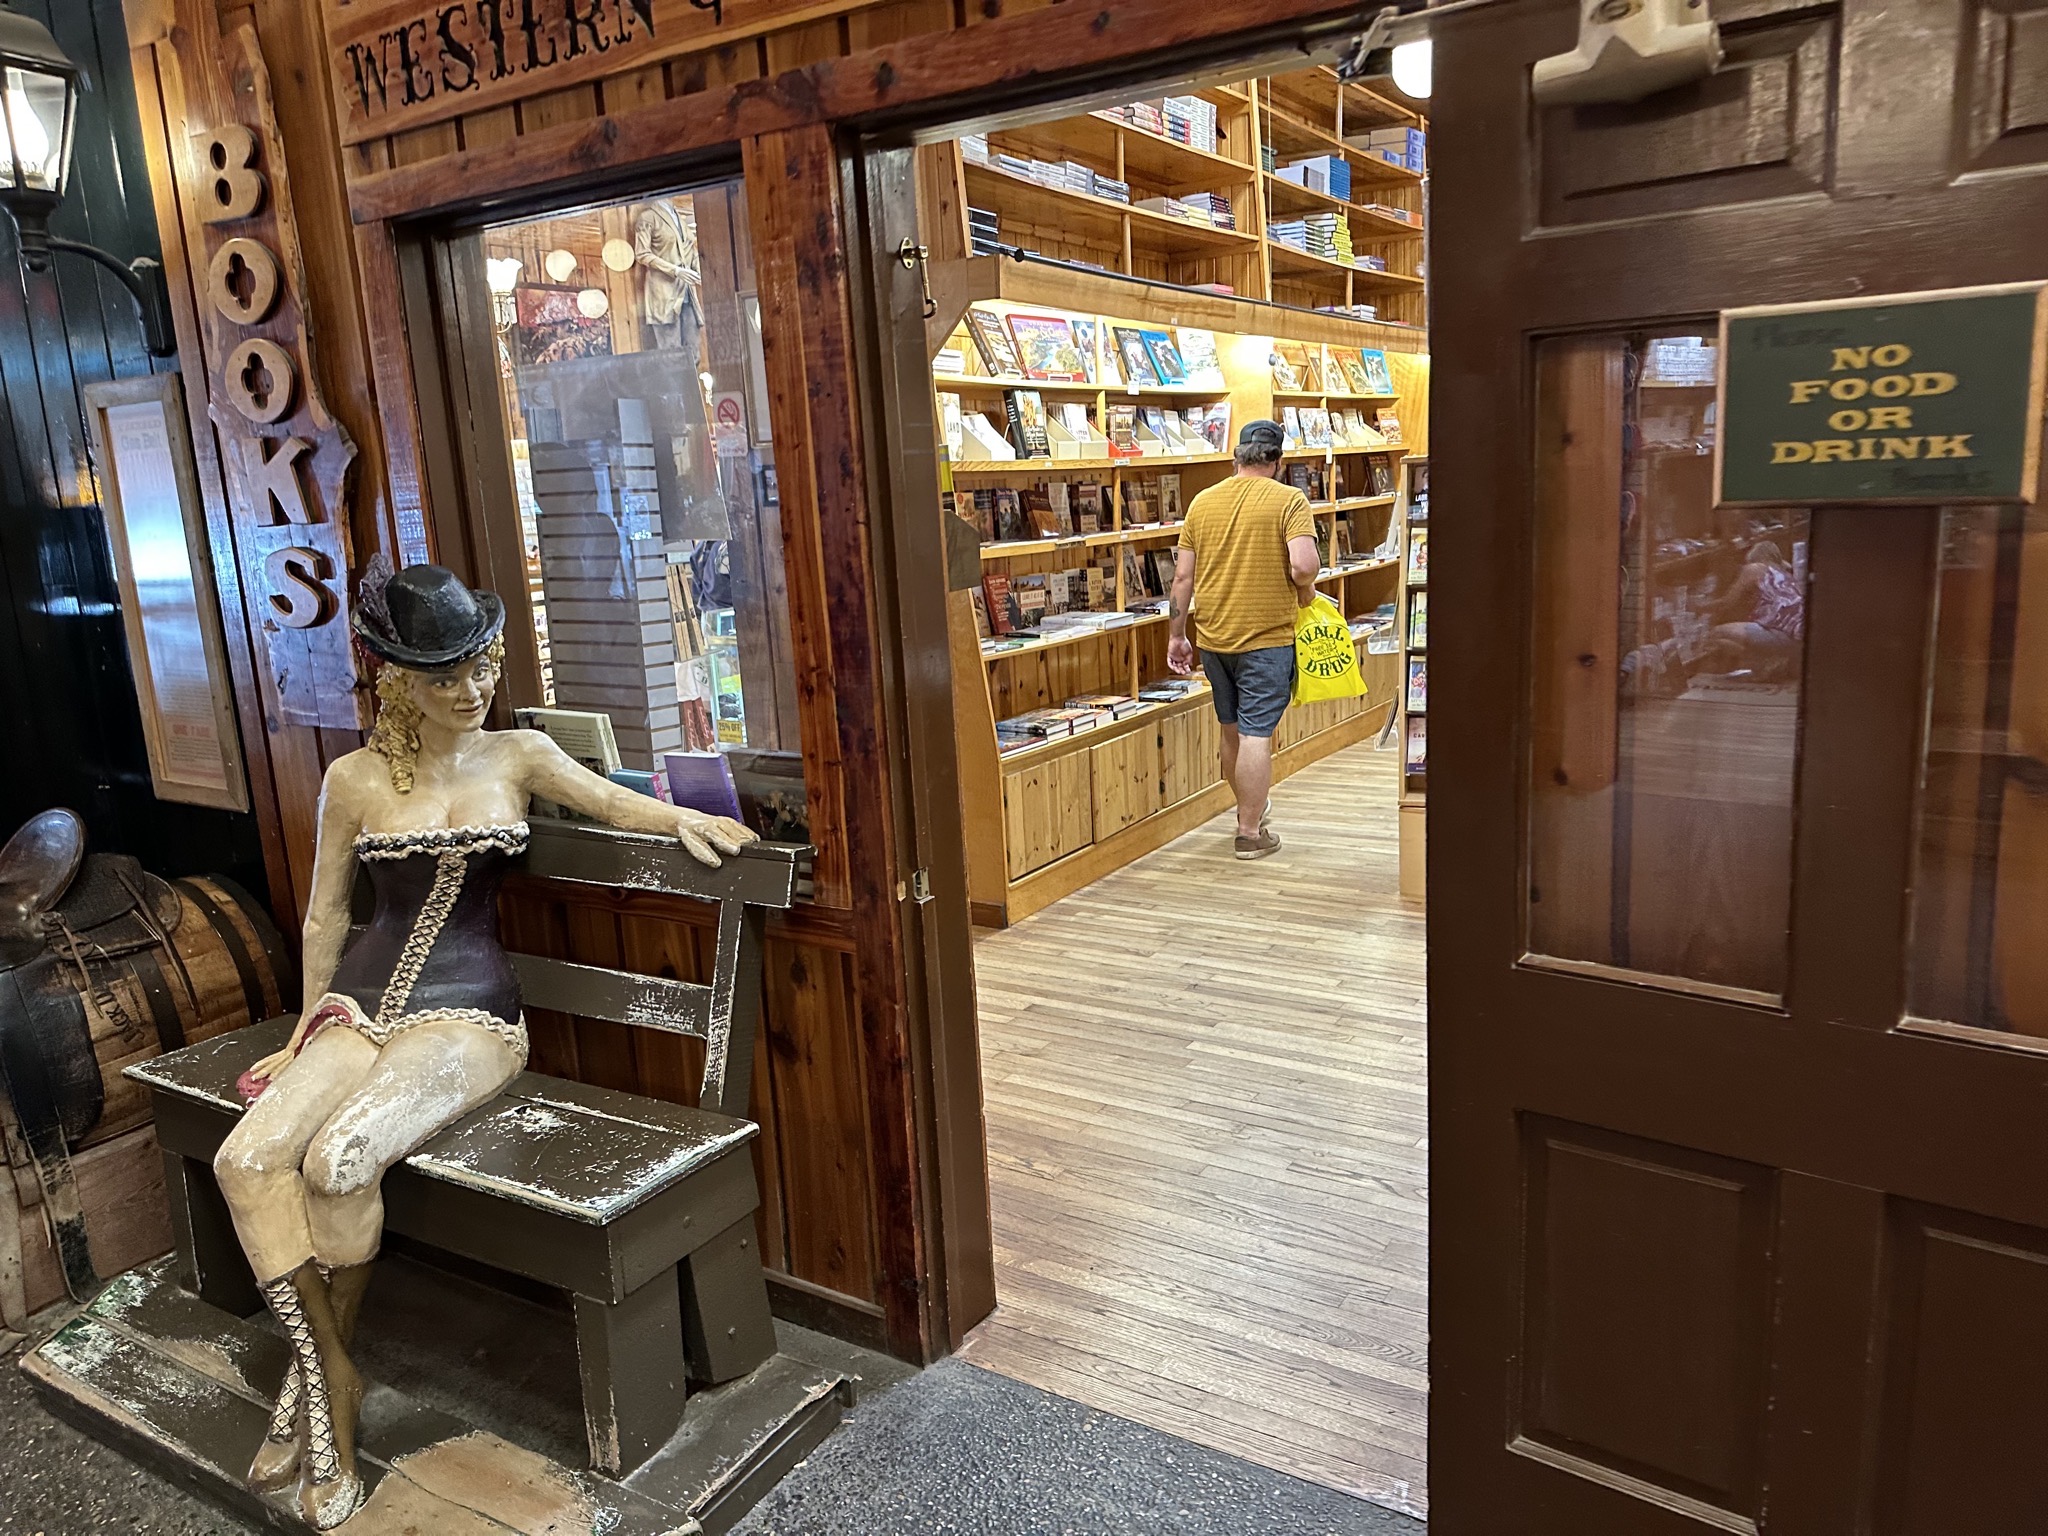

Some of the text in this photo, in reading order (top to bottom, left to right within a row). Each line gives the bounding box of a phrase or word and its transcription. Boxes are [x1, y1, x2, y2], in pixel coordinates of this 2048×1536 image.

[1830, 343, 1913, 372] NO
[192, 124, 326, 629] BOOKS
[1789, 372, 1959, 404] FOOD
[1827, 406, 1914, 432] OR
[1769, 434, 1976, 465] DRINK
[1297, 625, 1345, 646] WALL
[1304, 652, 1353, 677] DRUG
[106, 1003, 145, 1043] JACK
